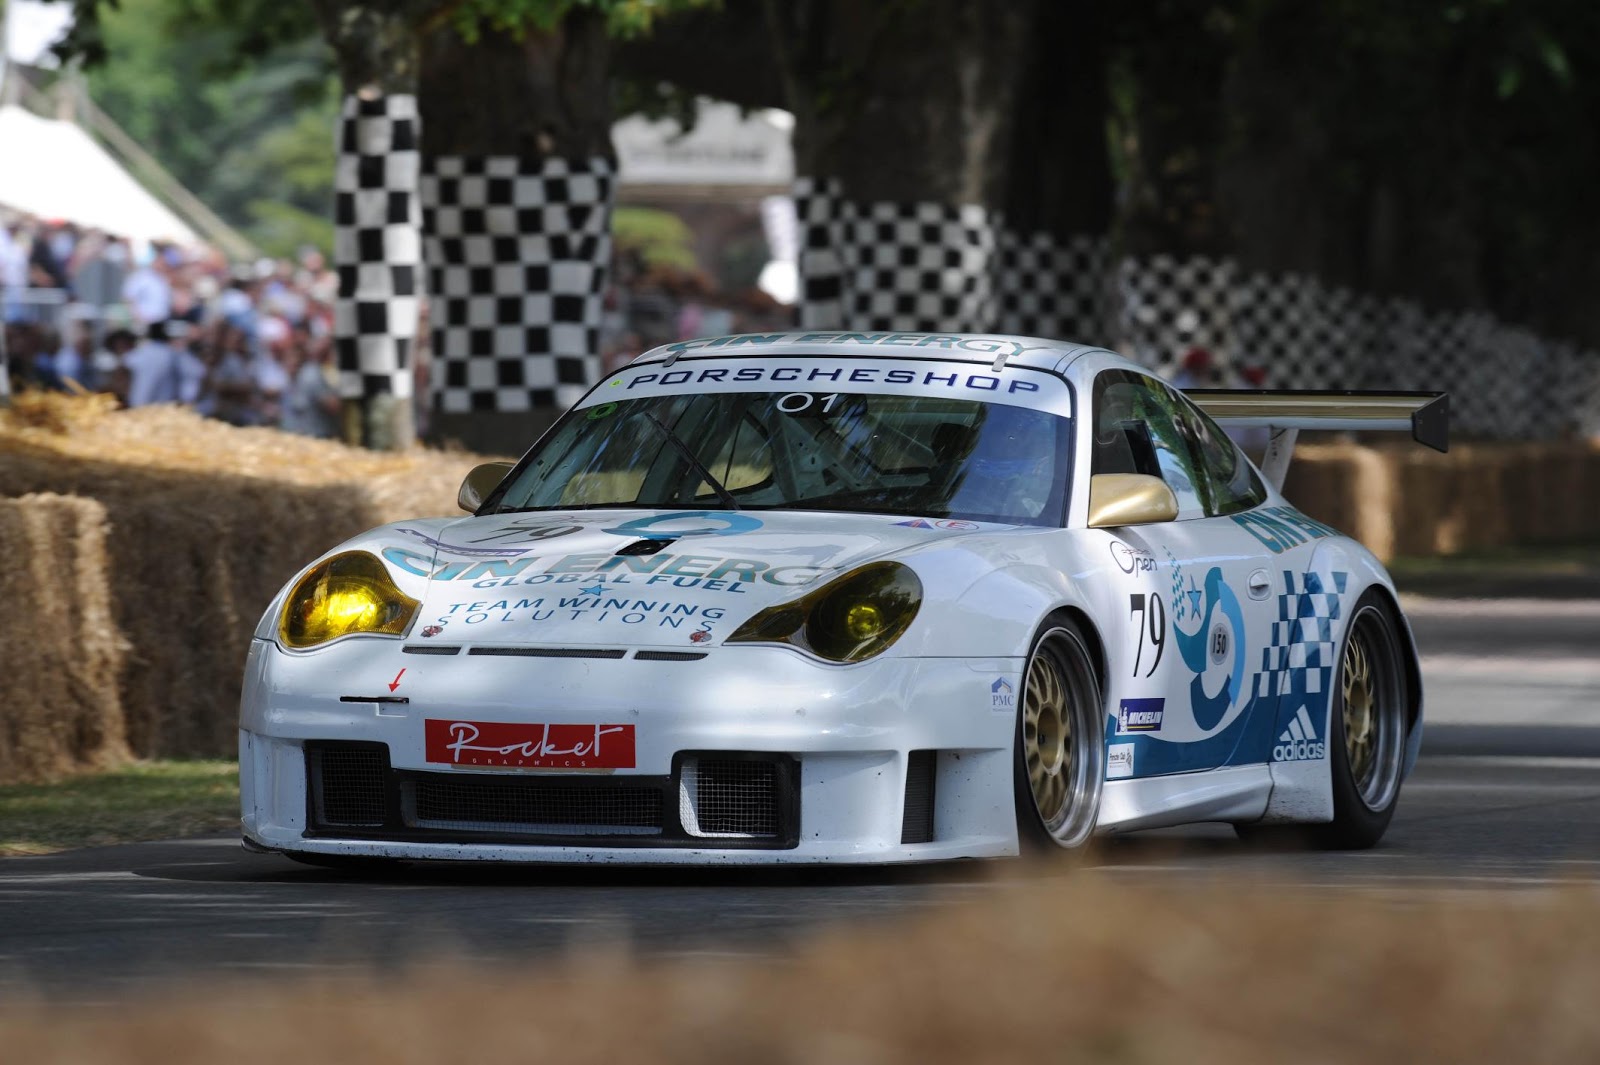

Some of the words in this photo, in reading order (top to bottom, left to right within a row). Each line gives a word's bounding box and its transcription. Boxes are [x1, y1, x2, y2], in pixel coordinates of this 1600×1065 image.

[666, 333, 789, 351] CIN
[794, 333, 1050, 356] ENERGY
[626, 368, 1041, 394] PORSCHESHOP
[467, 525, 585, 545] 79
[382, 547, 541, 581] CIN
[1109, 541, 1158, 578] Open
[472, 573, 631, 589] GLOBAL
[645, 575, 746, 594] FUEL
[449, 598, 545, 614] TEAM
[558, 598, 726, 619] WINNING
[437, 610, 717, 633] SOLUTIONS
[1130, 592, 1166, 678] 79
[1212, 633, 1227, 655] 150
[992, 694, 1015, 706] PMC
[1128, 711, 1163, 725] MICHELIN
[446, 723, 623, 762] Rocket
[1273, 739, 1325, 762] adidas
[472, 758, 586, 767] GRAPHICS
